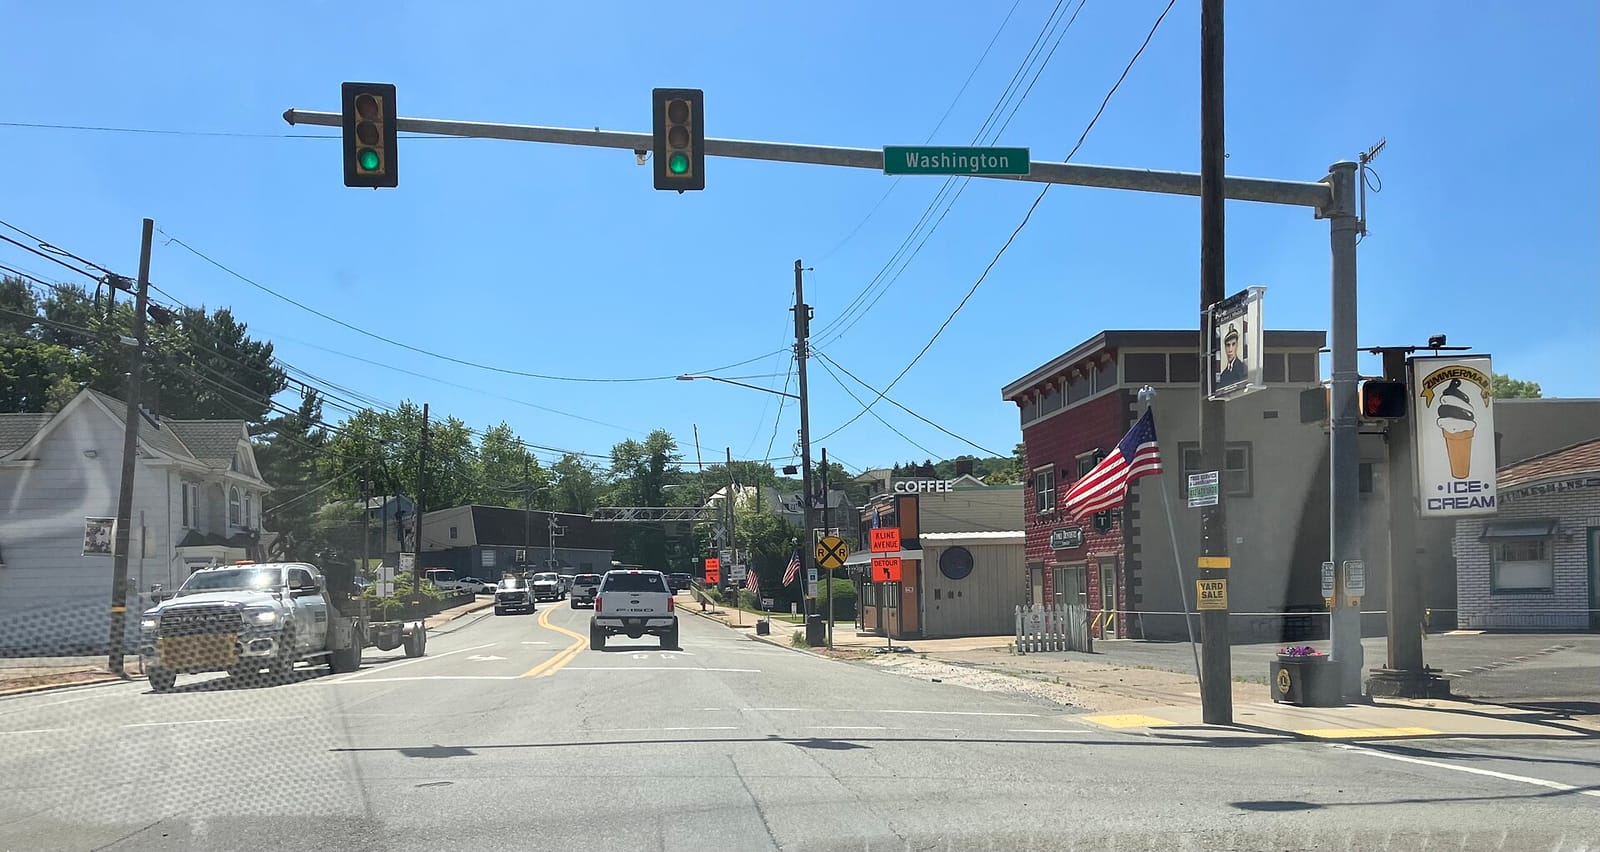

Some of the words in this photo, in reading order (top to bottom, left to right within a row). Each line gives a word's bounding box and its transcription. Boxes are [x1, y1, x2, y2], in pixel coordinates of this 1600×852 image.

[906, 152, 1008, 172] Washington
[894, 480, 953, 493] COFFEE
[1447, 481, 1481, 494] ICE
[1427, 495, 1495, 510] CREAM
[876, 532, 895, 540] KLINE
[874, 541, 898, 549] AVENUE
[818, 549, 825, 557] R
[839, 549, 846, 557] R
[1200, 582, 1224, 591] YARD
[1201, 591, 1224, 599] SALE
